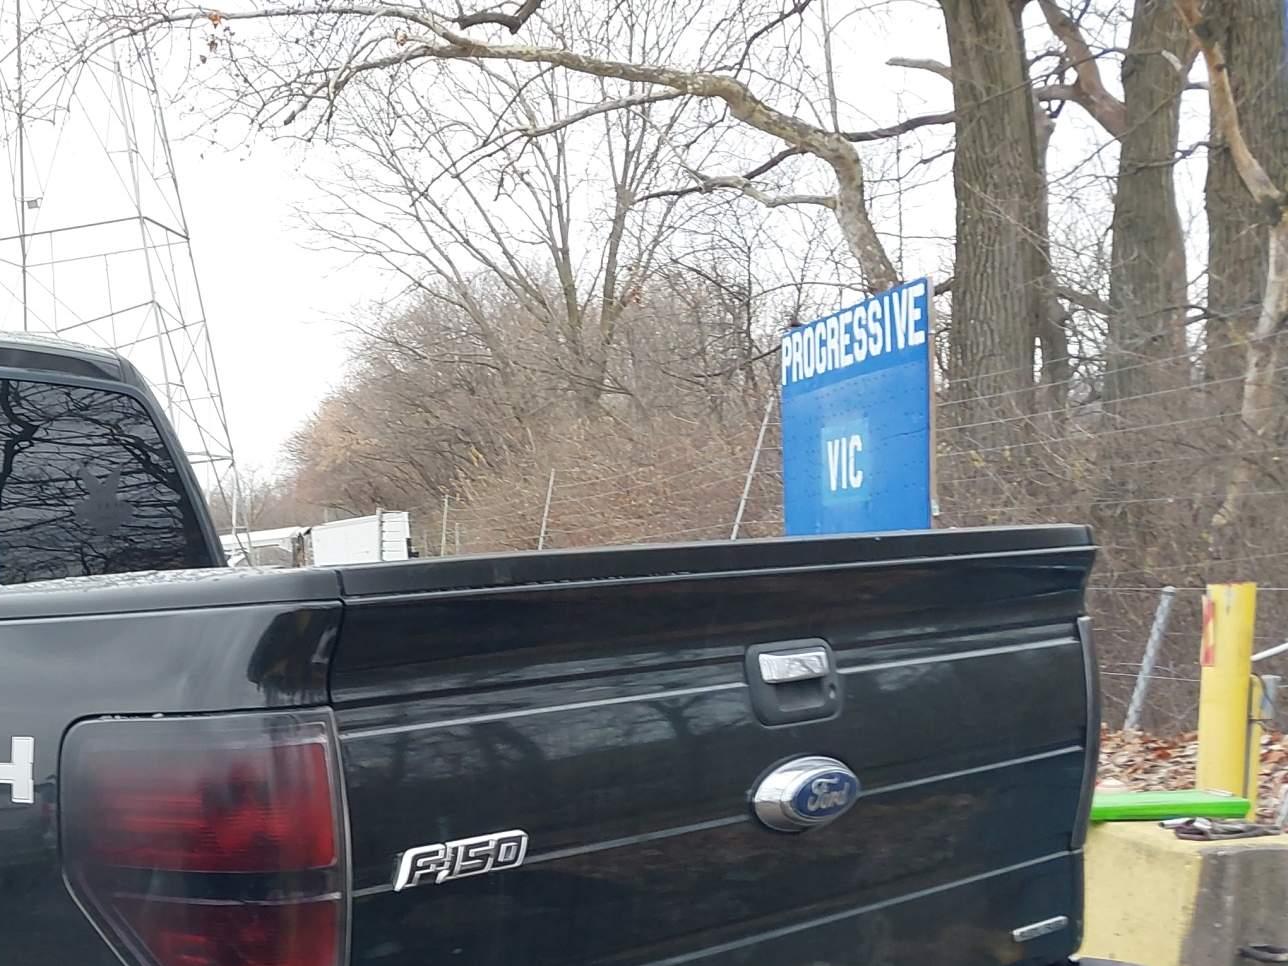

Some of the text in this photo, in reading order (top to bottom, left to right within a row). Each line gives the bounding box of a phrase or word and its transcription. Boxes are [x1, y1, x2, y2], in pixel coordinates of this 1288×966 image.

[782, 282, 926, 386] PROGRESSIVE
[827, 434, 863, 491] VIC
[807, 777, 850, 812] Ford
